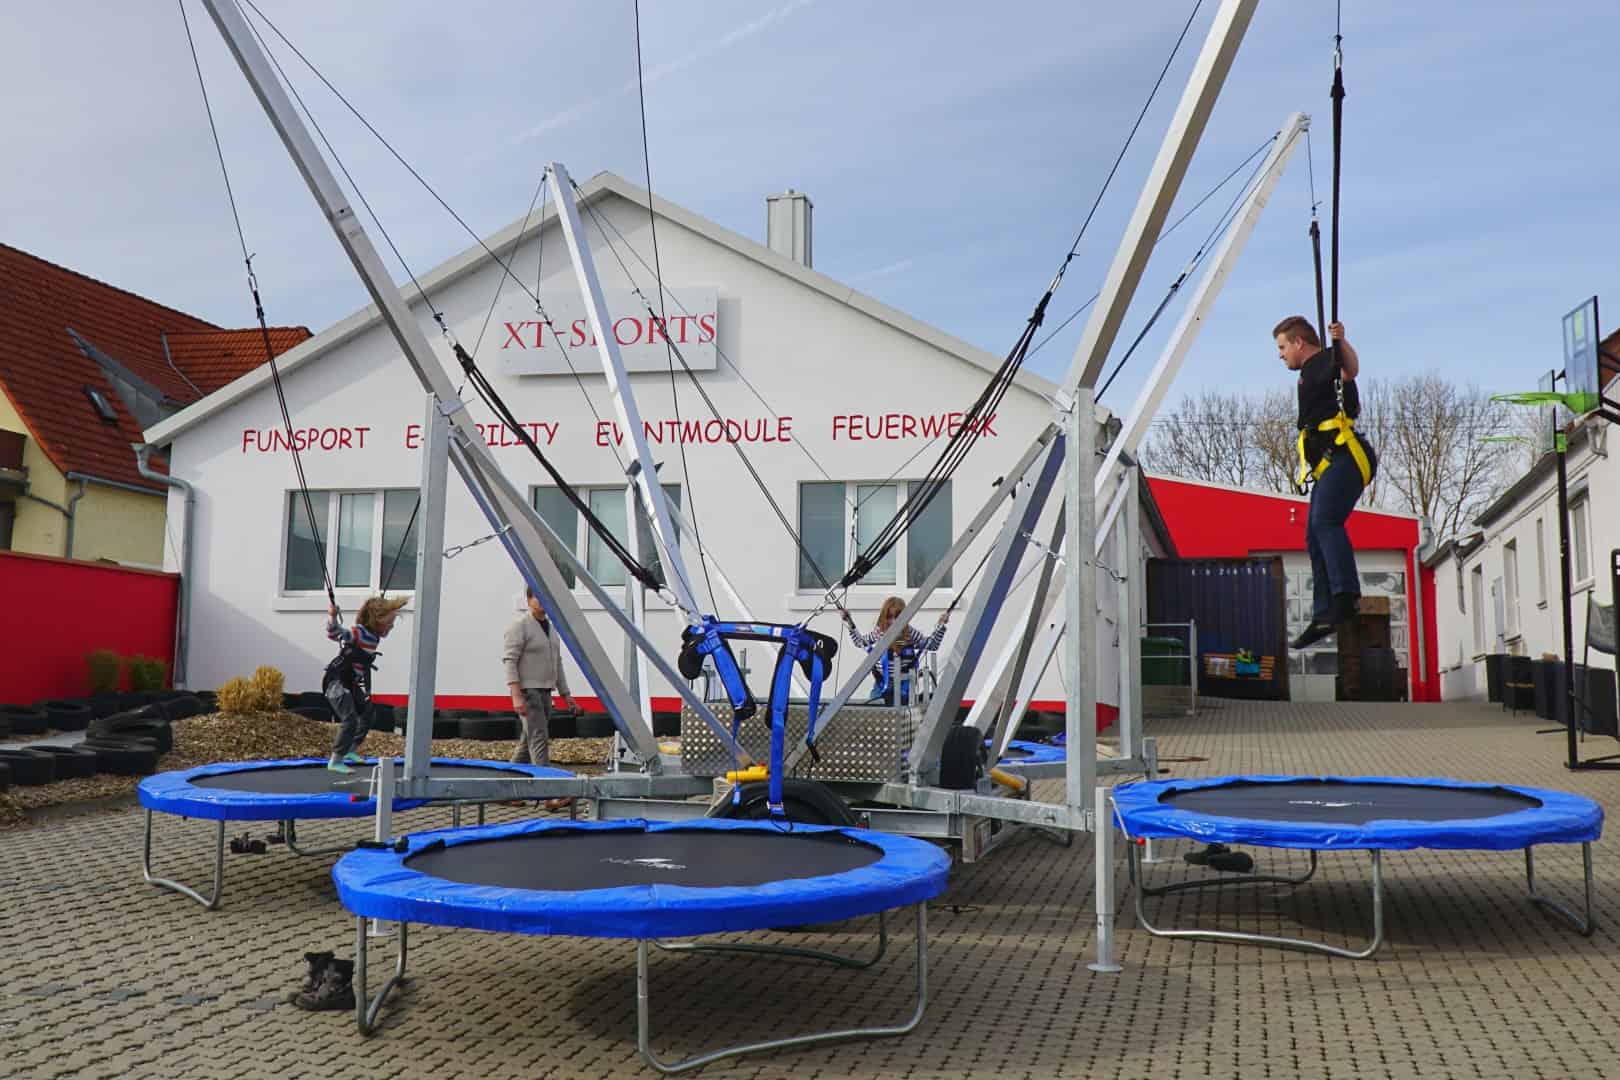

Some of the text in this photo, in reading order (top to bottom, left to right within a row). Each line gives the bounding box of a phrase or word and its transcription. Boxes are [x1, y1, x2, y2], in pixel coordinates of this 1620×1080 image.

[502, 313, 717, 350] XT-SORTS
[242, 426, 370, 453] FUNSPORT
[405, 421, 559, 449] E-ILITY
[596, 416, 792, 447] EVNTMODULE
